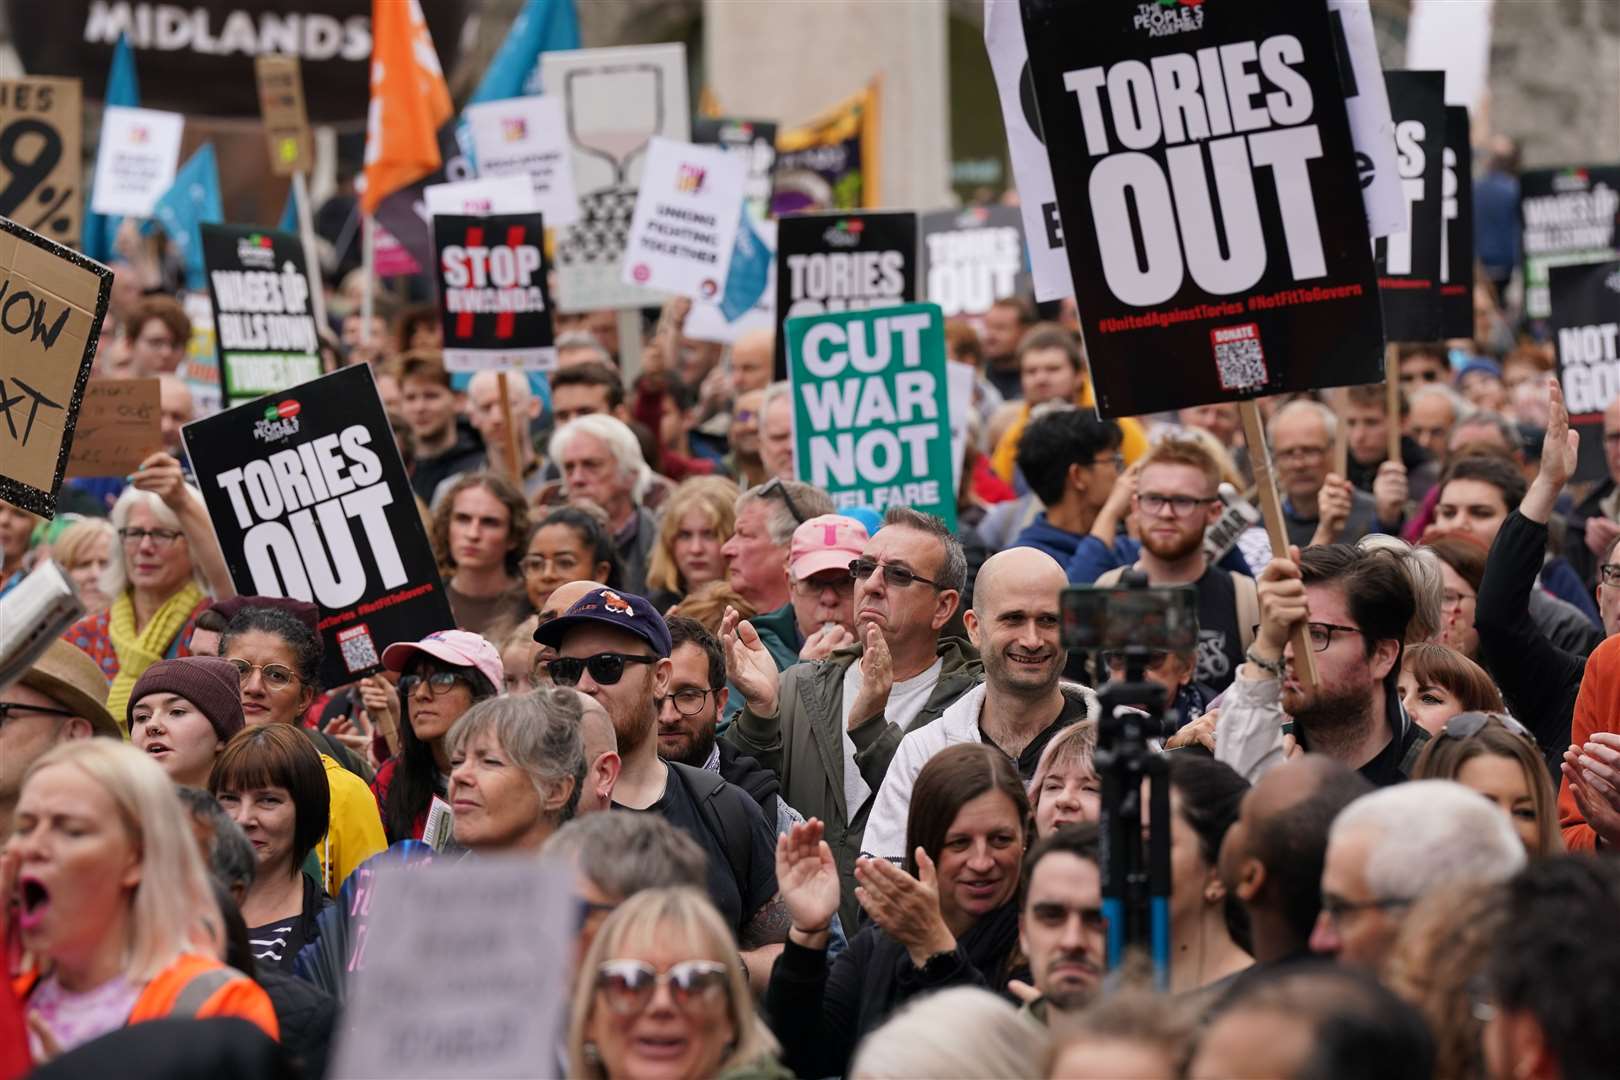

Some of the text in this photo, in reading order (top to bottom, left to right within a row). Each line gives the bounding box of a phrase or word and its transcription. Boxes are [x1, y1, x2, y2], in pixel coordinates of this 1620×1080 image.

[84, 1, 372, 61] MIDLANDS
[1063, 34, 1314, 157] TORIES
[1088, 124, 1328, 307] OUT
[441, 245, 541, 288] STOP
[786, 249, 905, 300] TORIES
[927, 261, 1020, 317] OUT
[445, 285, 545, 313] RWANDA
[1099, 284, 1363, 333] #UnitedAgainstTories #NotFitToGovern
[802, 312, 931, 377] CUT
[1558, 323, 1619, 366] NOT
[801, 370, 938, 431] WAR
[216, 424, 383, 530] TORIES
[809, 423, 939, 487] NOT
[243, 480, 410, 609] OUT
[1208, 509, 1250, 550] WAR
